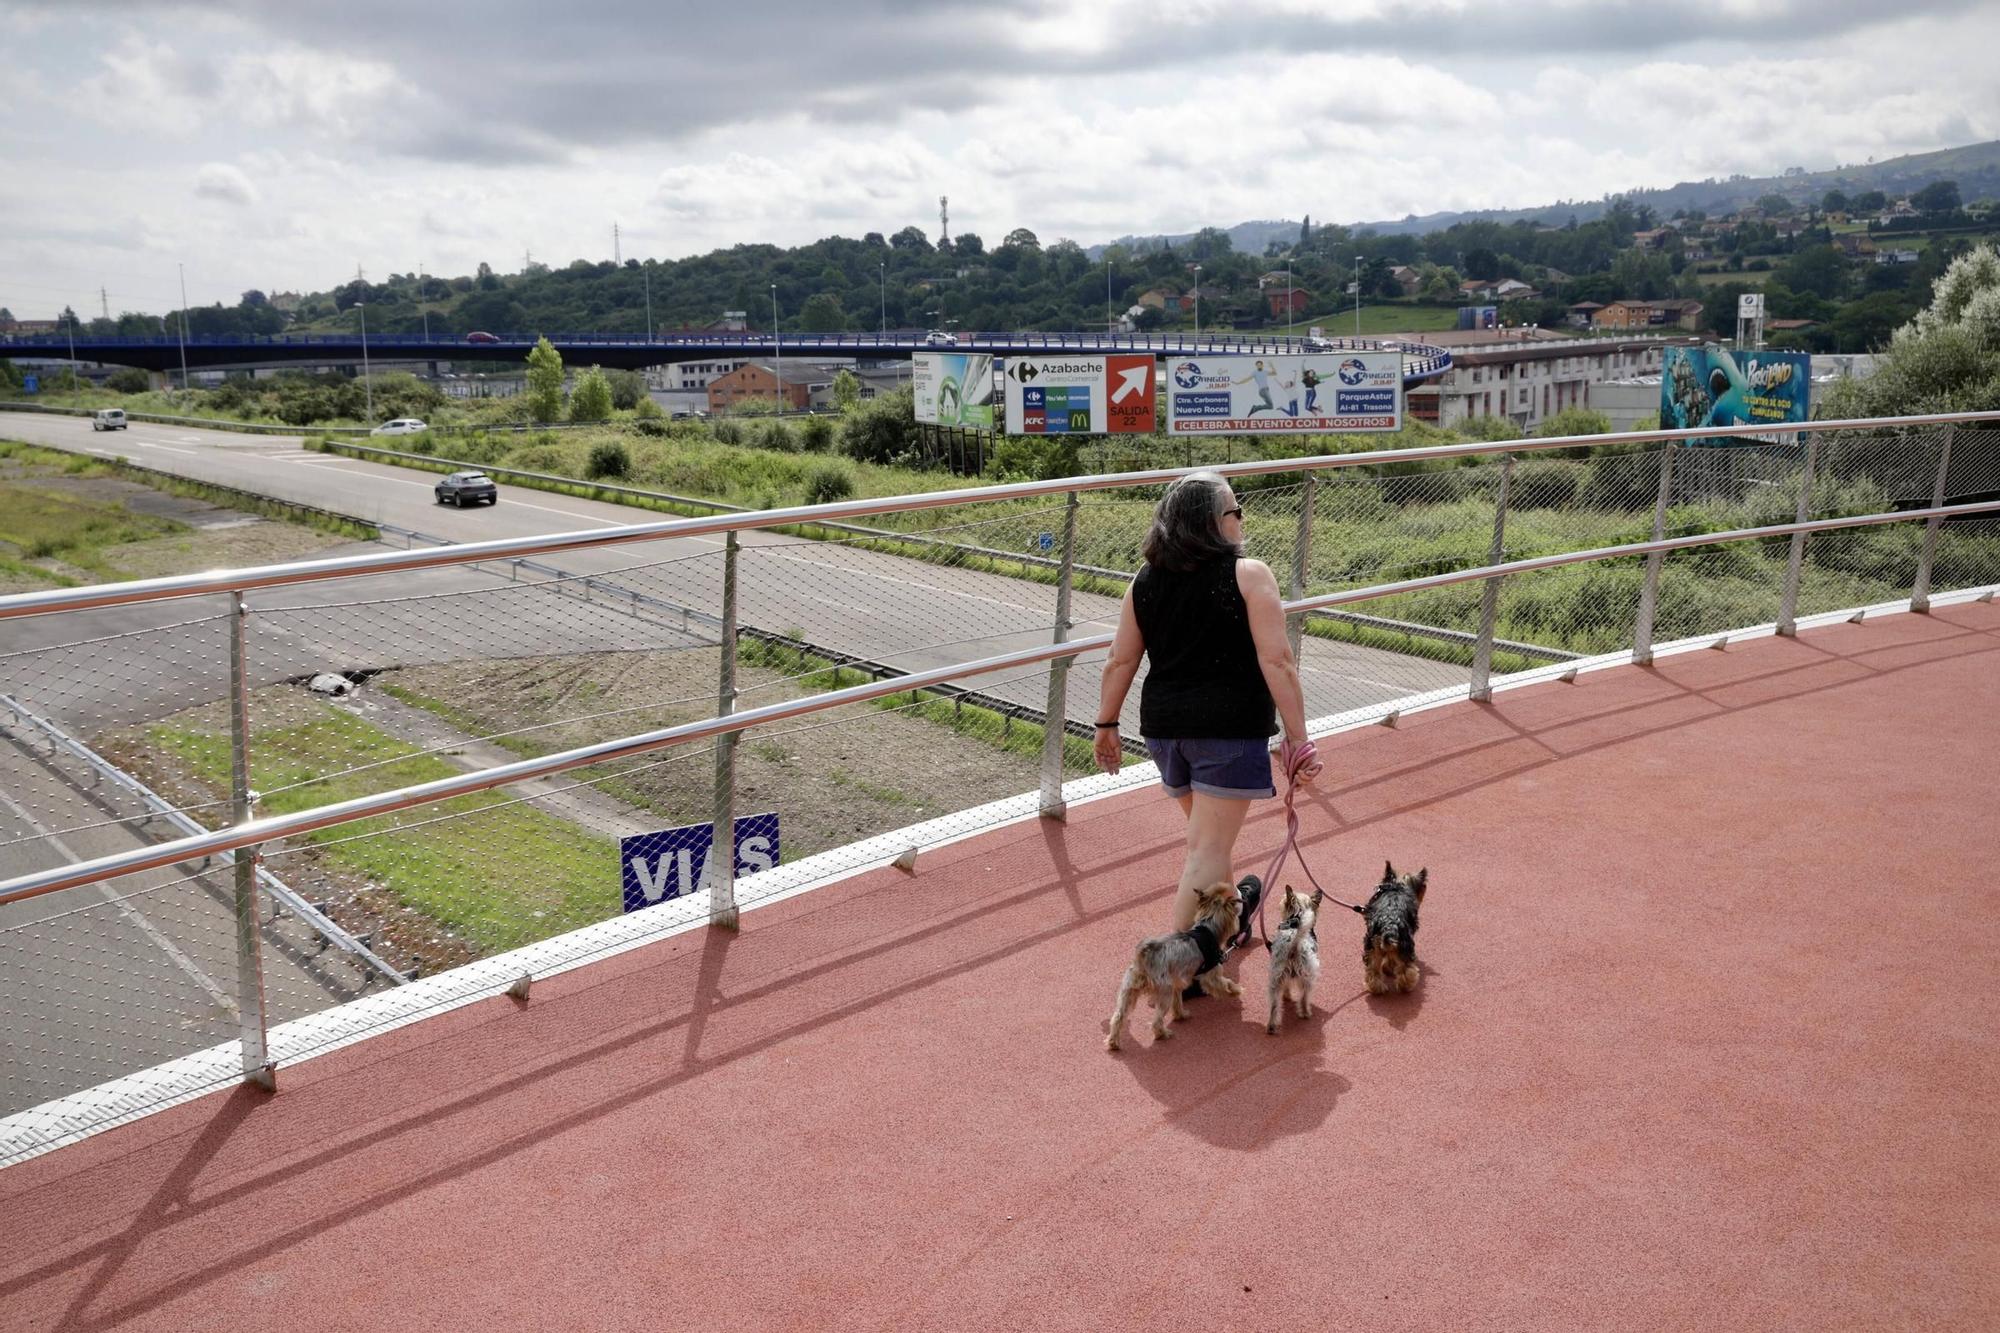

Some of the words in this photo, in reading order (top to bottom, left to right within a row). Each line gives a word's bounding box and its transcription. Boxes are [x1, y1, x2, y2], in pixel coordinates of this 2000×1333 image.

[1041, 362, 1103, 374] Azabache
[1110, 406, 1150, 416] SALIDA
[1025, 417, 1044, 425] KFC
[1123, 416, 1137, 426] 22
[1179, 421, 1231, 430] ¡CELEBRA
[1233, 420, 1247, 429] TU
[1250, 420, 1294, 429] EVENTO
[1295, 419, 1320, 428] CON
[1325, 418, 1389, 427] NOSOTROS!
